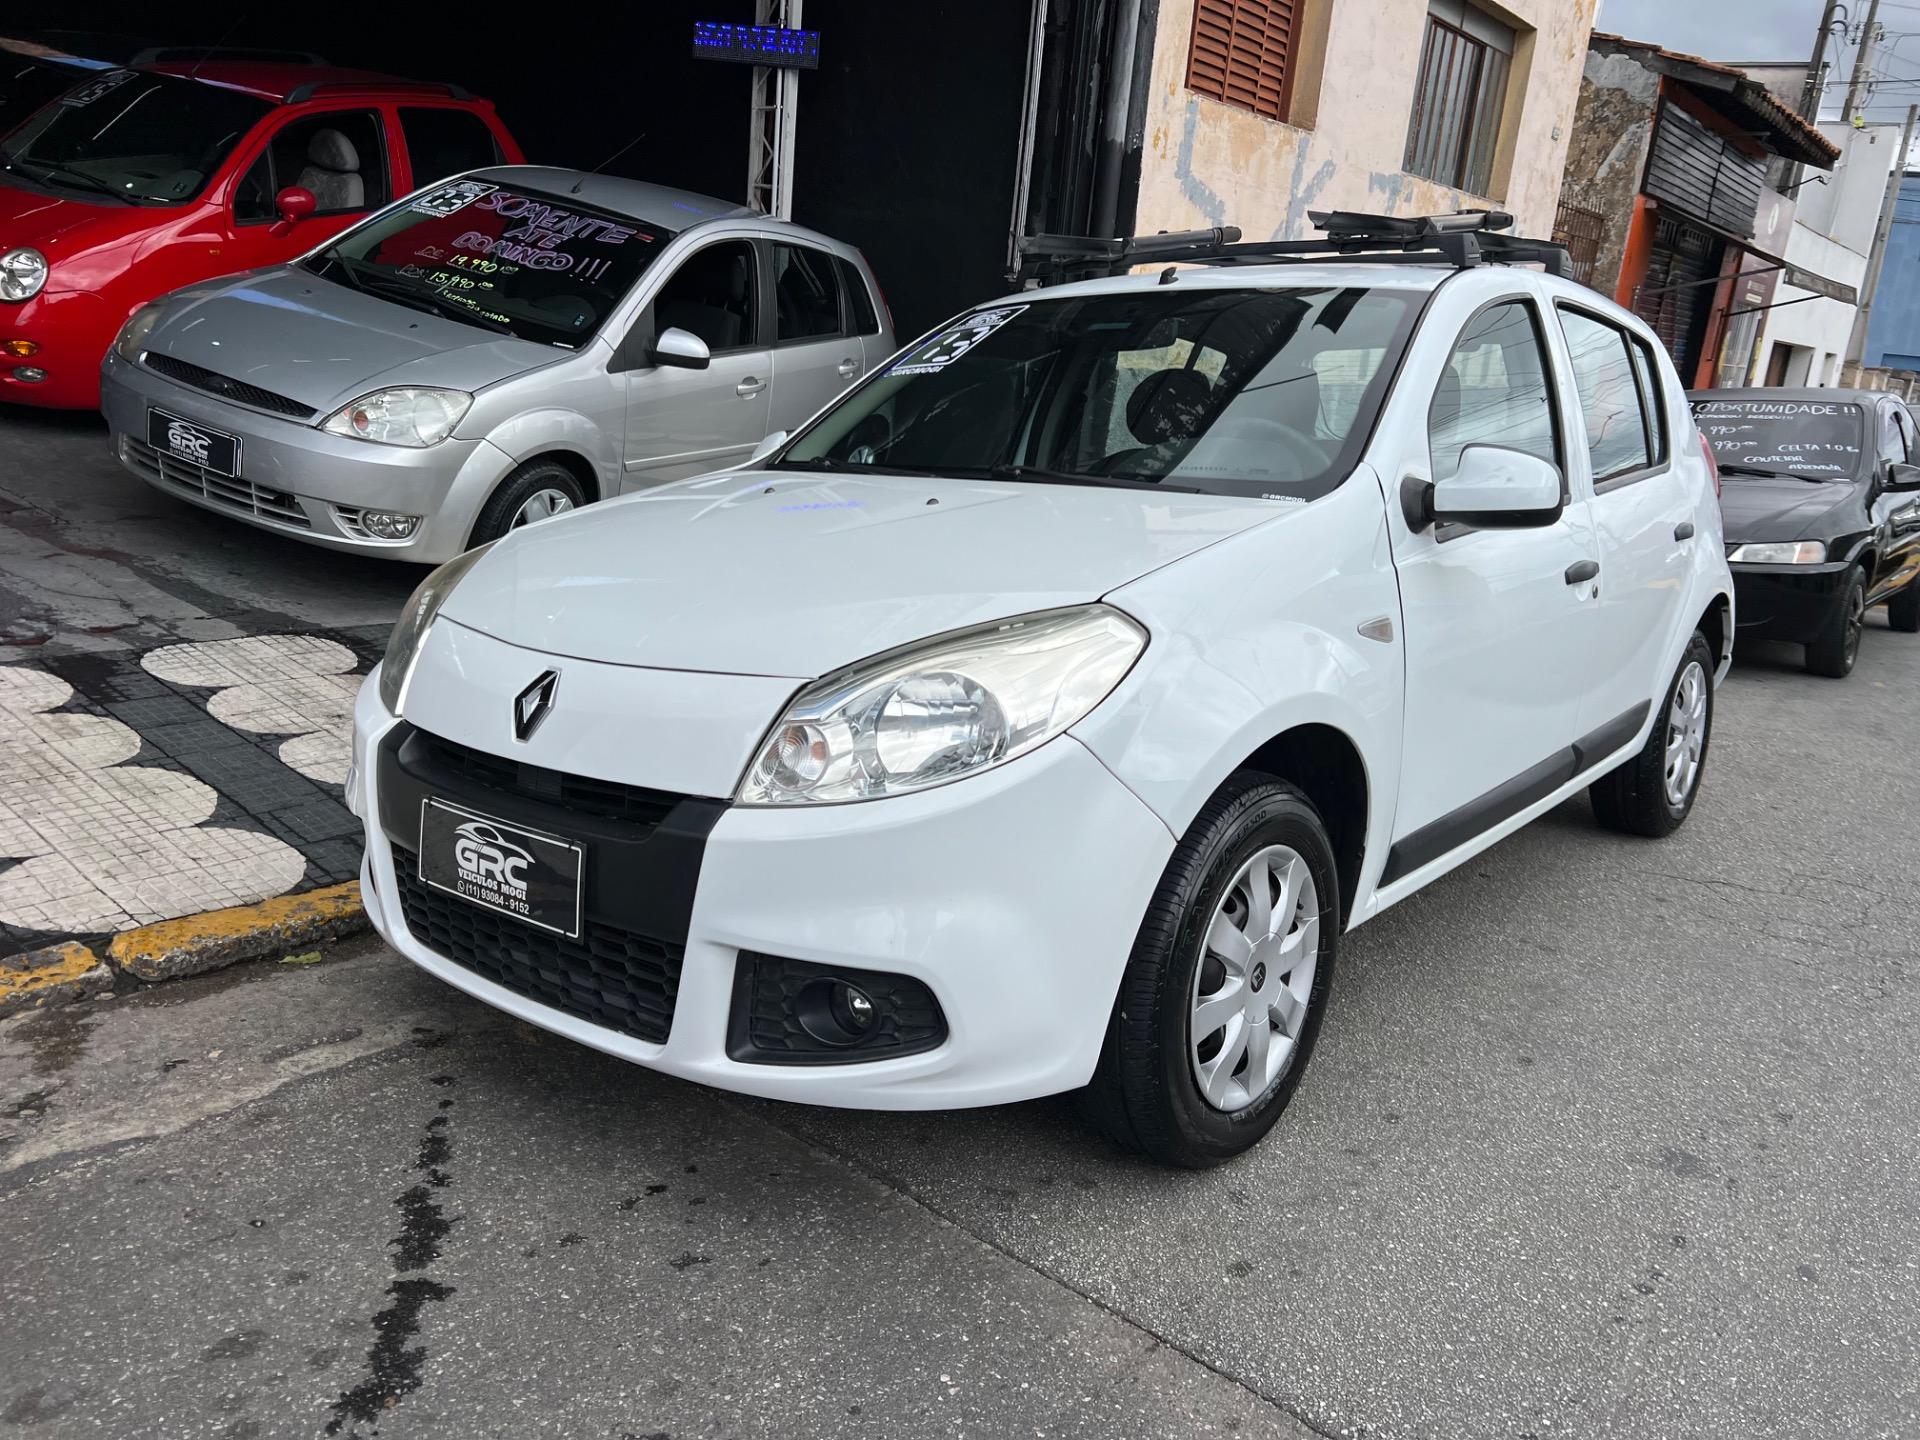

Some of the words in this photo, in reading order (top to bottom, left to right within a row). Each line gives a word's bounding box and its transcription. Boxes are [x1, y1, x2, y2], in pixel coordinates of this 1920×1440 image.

[475, 192, 638, 244] SOMENTE
[1696, 402, 1838, 416] OPORTUNIDADE
[168, 428, 209, 456] GRC
[1777, 443, 1820, 453] CELTA
[455, 838, 528, 891] GRC
[458, 868, 498, 889] VEICULOS
[501, 884, 526, 900] MOGI
